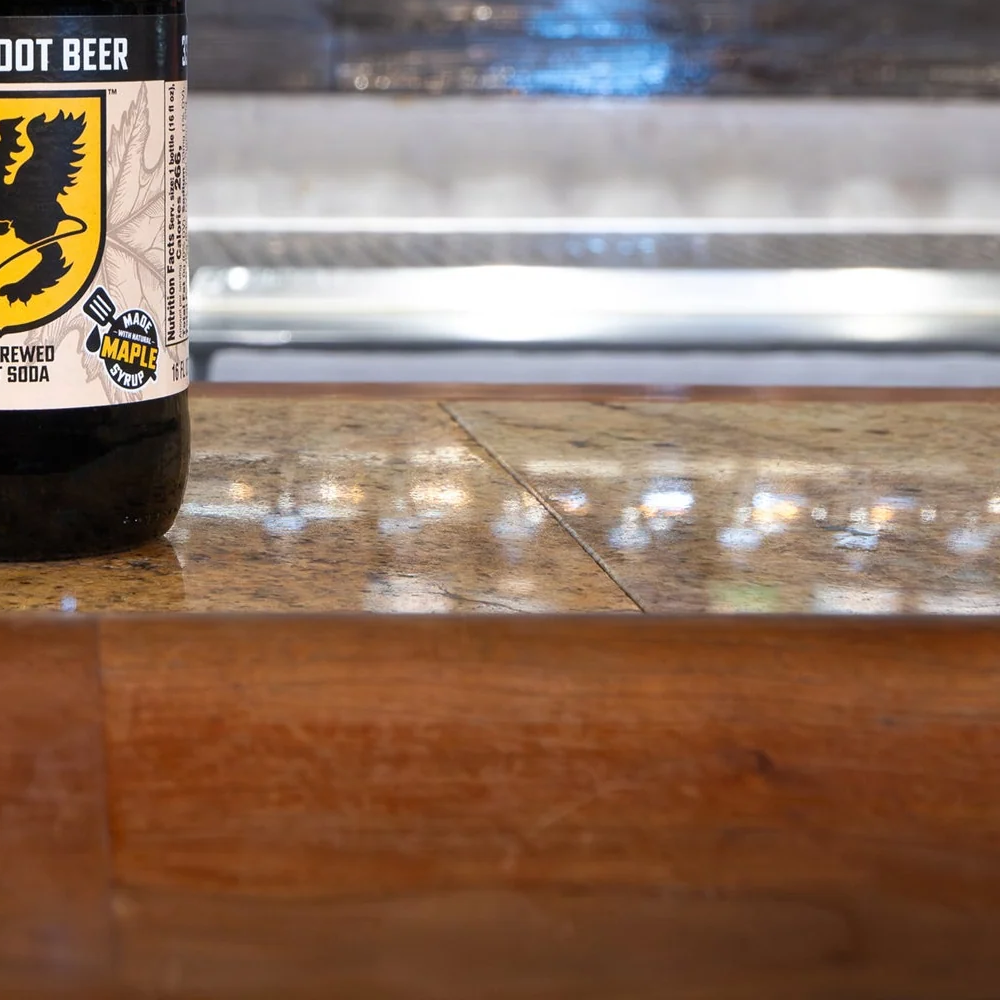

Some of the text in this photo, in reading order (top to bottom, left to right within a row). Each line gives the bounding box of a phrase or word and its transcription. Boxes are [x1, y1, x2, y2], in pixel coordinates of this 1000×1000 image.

[63, 38, 128, 71] BEER
[167, 233, 175, 274] Facts
[122, 312, 152, 334] MADE
[167, 277, 176, 341] Nutrition
[118, 329, 152, 345] WITH NATURAL
[101, 335, 158, 370] MAPLE
[7, 365, 50, 383] SODA
[109, 363, 145, 387] SYRUP
